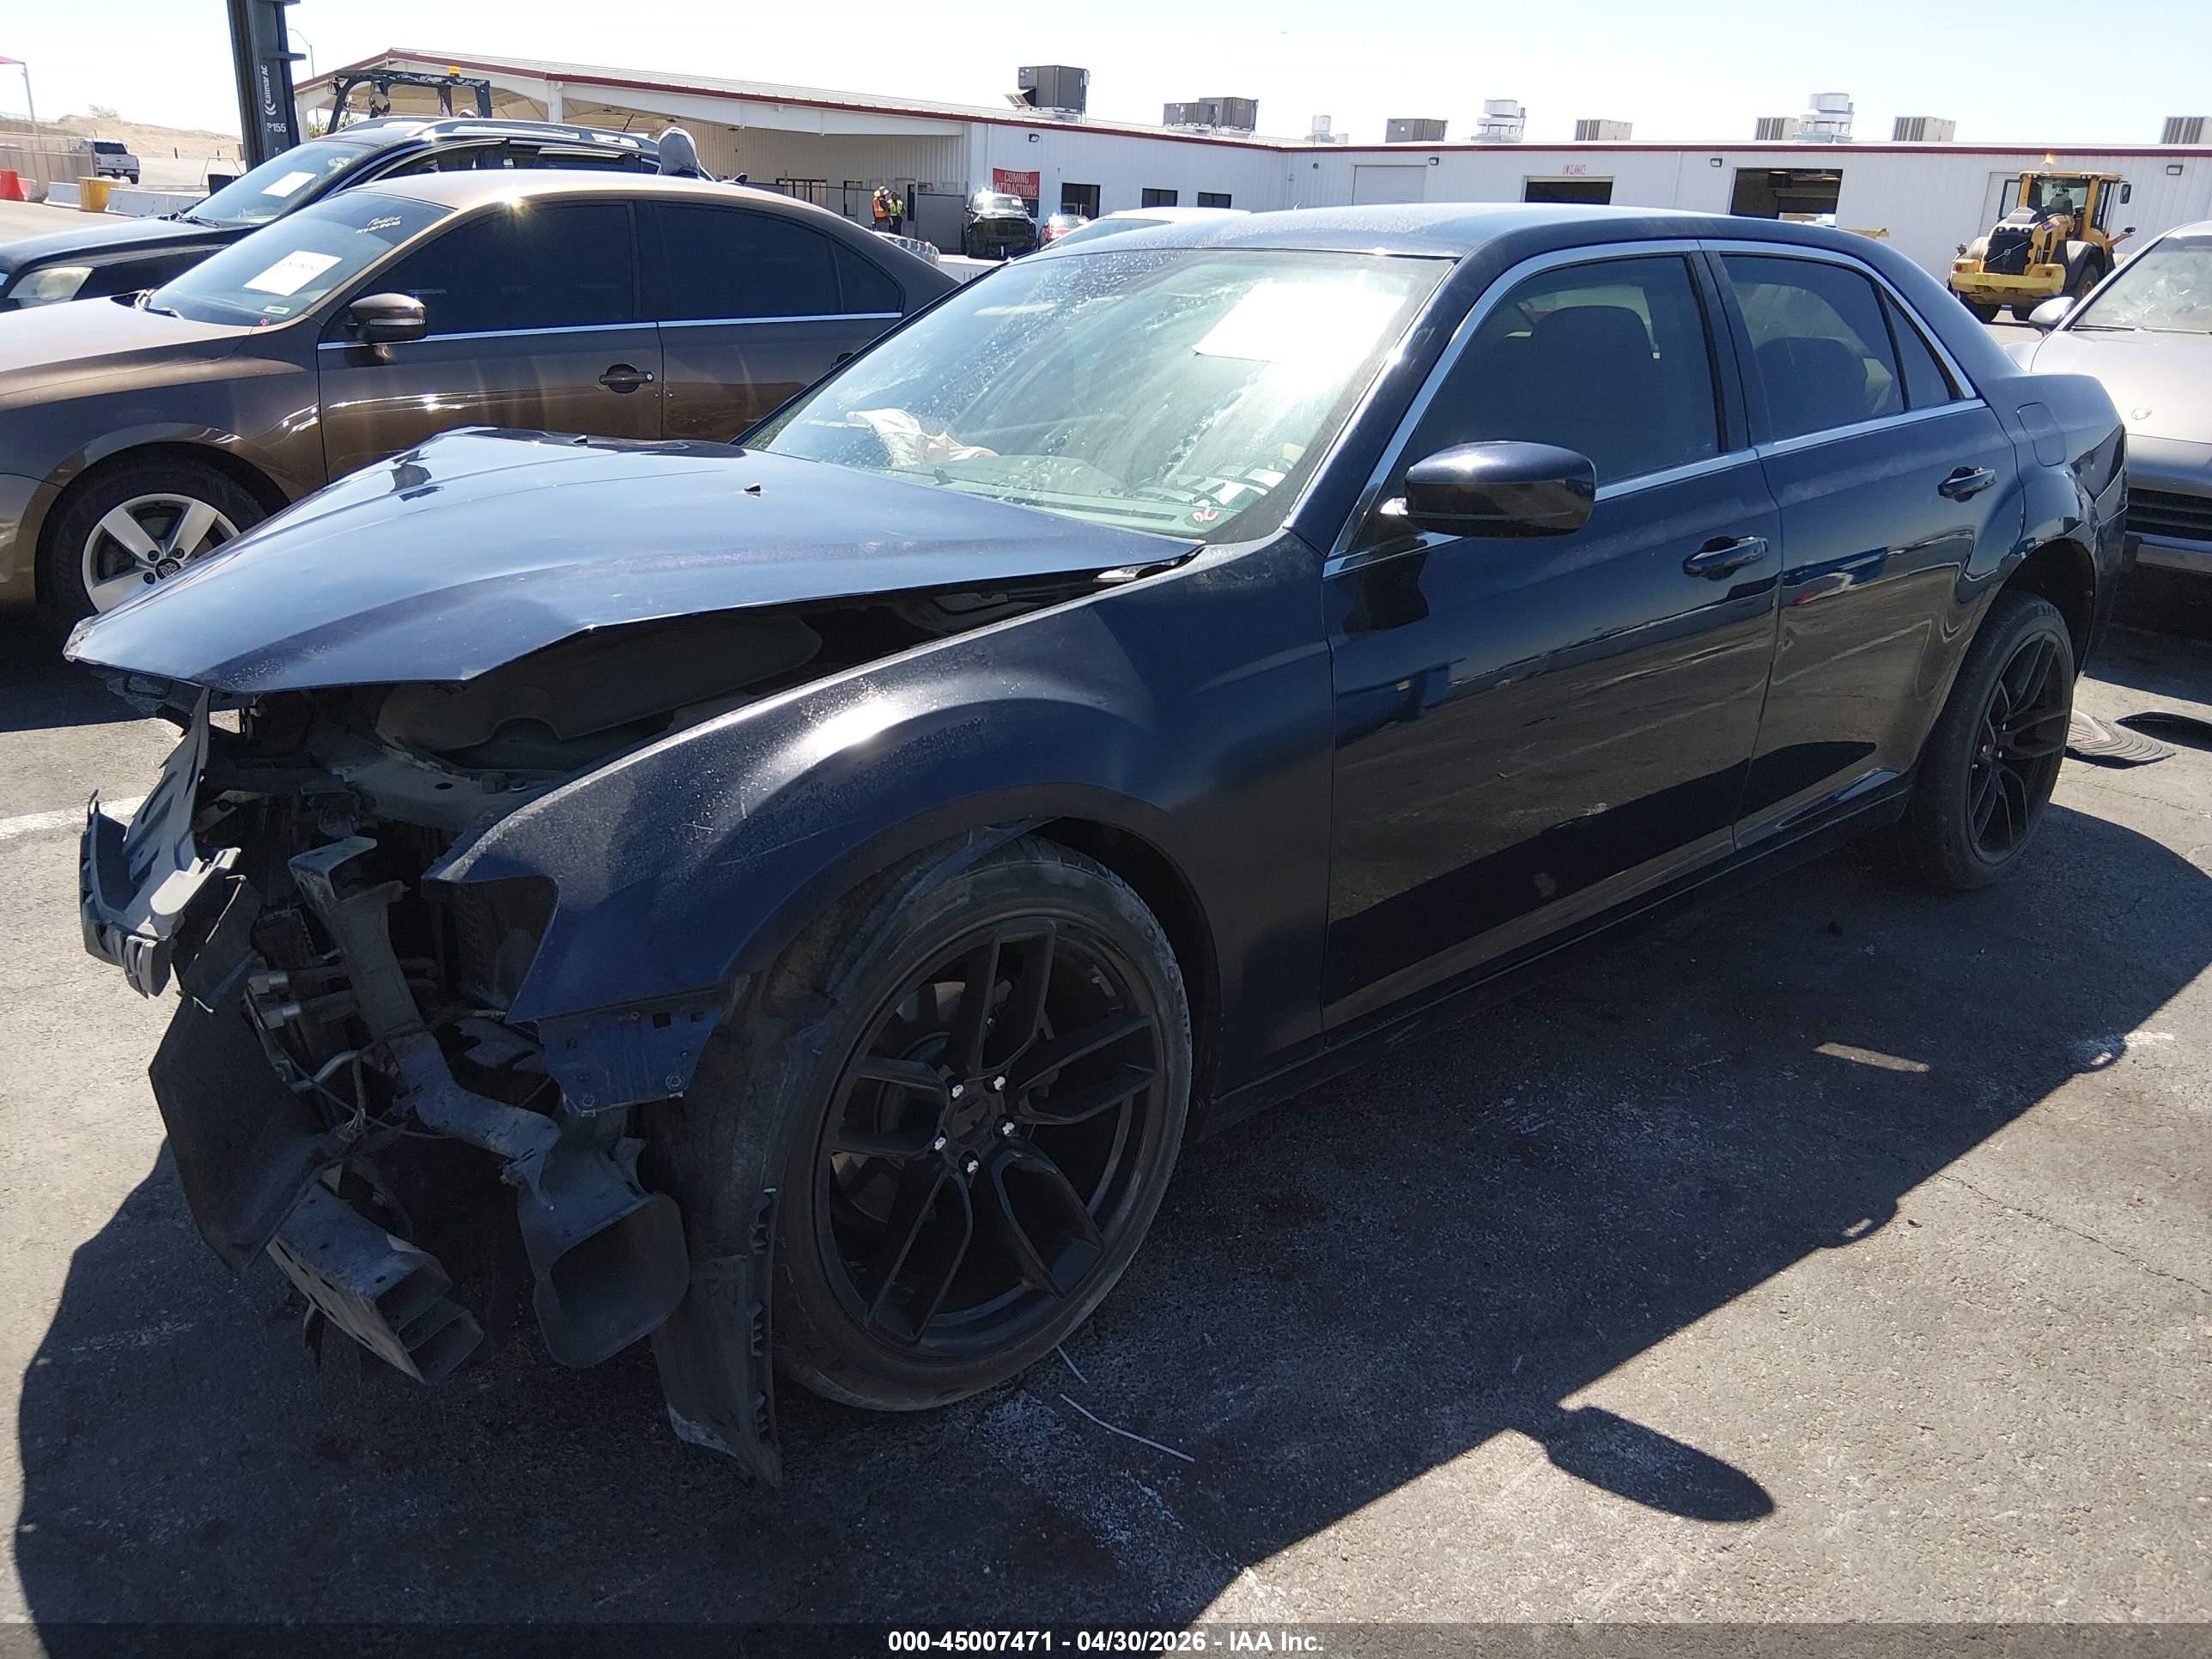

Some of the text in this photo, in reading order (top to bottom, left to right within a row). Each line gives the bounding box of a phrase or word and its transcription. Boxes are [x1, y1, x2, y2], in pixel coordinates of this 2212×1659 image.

[260, 64, 269, 76] AC
[1004, 171, 1030, 185] COMING
[995, 182, 1037, 197] ATTRACTIONS
